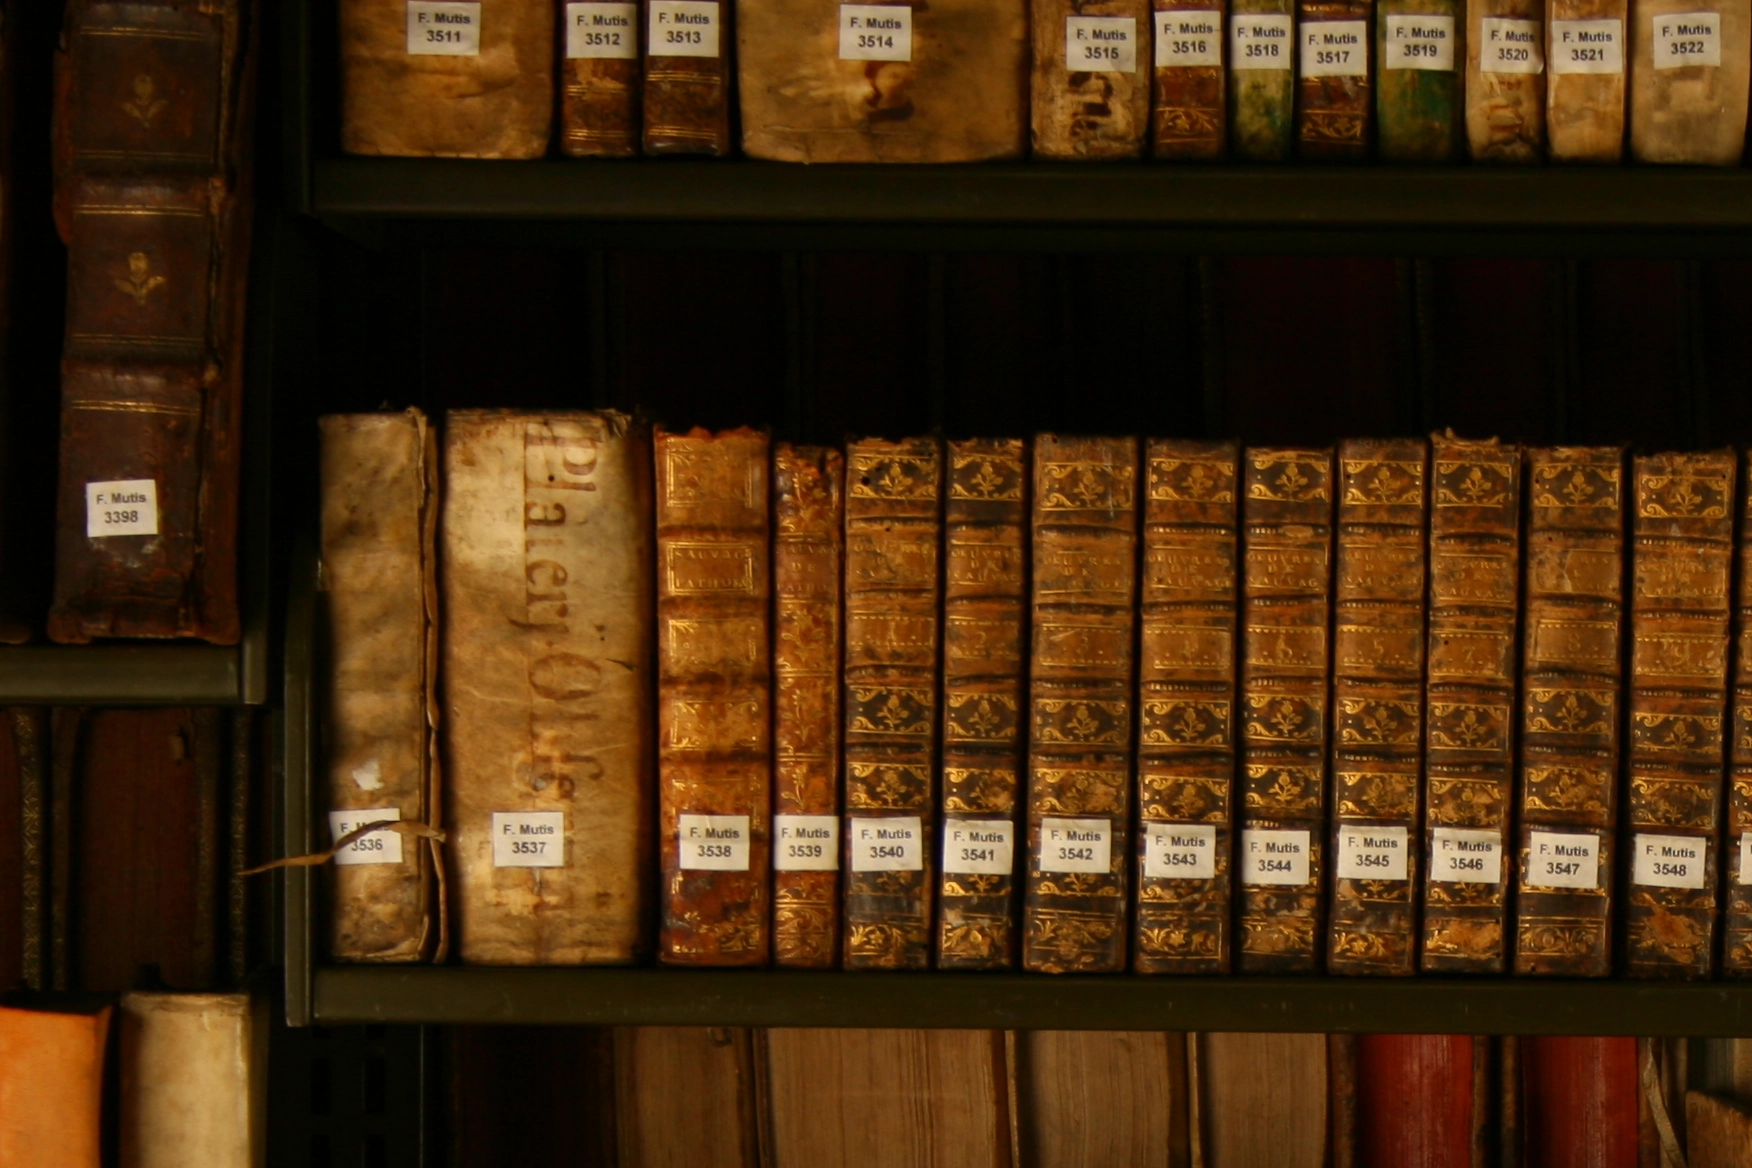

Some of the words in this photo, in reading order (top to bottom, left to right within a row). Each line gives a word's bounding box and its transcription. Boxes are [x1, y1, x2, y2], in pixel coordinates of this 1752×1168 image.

[417, 12, 430, 24] F.
[434, 12, 471, 24] Mutis
[426, 28, 461, 43] 3511
[585, 32, 621, 46] 3512
[666, 30, 702, 44] 3513
[857, 34, 894, 49] 3514
[1084, 46, 1120, 60] 3515
[1172, 40, 1207, 54] 3516
[1245, 43, 1280, 58] 3518
[1403, 44, 1438, 58] 3519
[1670, 40, 1705, 56] 3522
[1316, 50, 1350, 64] 3517
[1498, 47, 1529, 62] 3520
[1571, 48, 1604, 62] 3521
[96, 494, 108, 505] F.
[111, 492, 148, 504] Mutis
[104, 510, 139, 524] 3398
[350, 838, 384, 852] 3536
[512, 841, 547, 854] 3537
[1348, 836, 1359, 848] F.
[1363, 836, 1399, 849] Mutis
[697, 844, 732, 858] 3538
[788, 844, 822, 858] 3539
[869, 845, 905, 859] 3540
[960, 848, 995, 862] 3541
[1058, 846, 1094, 861] 3542
[1162, 852, 1198, 866] 3543
[1257, 858, 1292, 873] 3544
[1355, 854, 1390, 868] 3545
[1449, 856, 1484, 871] 3546
[1545, 861, 1581, 876] 3547
[1652, 862, 1687, 877] 3548
